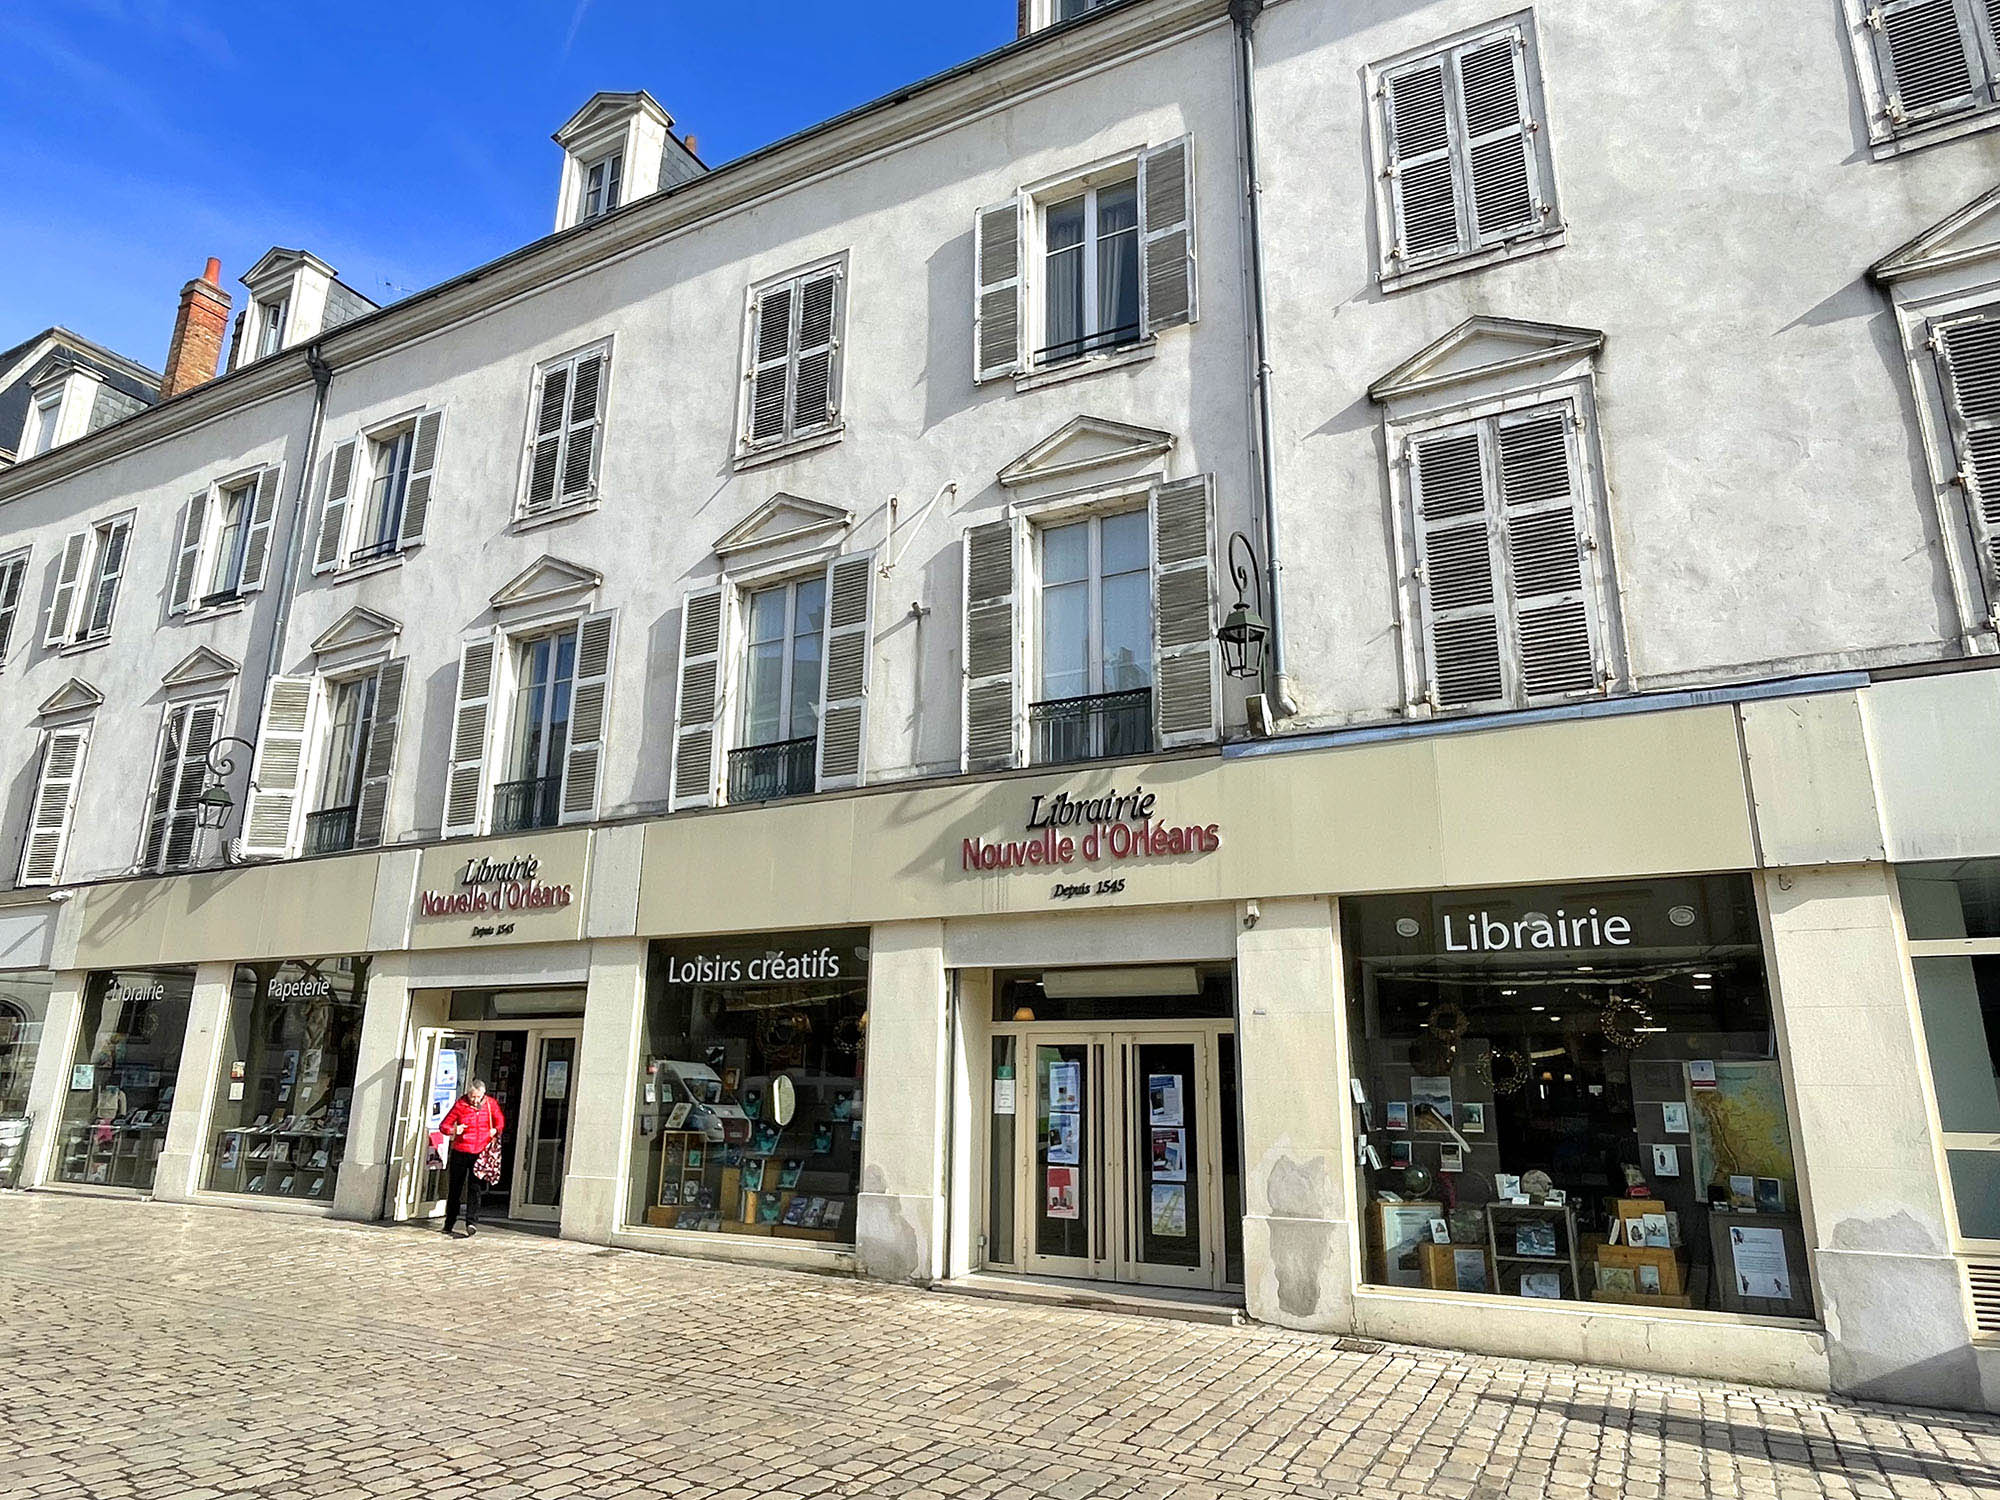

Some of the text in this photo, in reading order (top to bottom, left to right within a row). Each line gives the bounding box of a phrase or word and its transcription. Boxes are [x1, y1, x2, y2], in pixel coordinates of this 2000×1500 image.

[1025, 785, 1156, 831] Librairie
[962, 818, 1221, 870] Nouvelle d'Orléans
[461, 854, 539, 886] Librairie
[421, 879, 572, 916] Nouvelle d'Orléans
[1053, 878, 1126, 899] Depuis 1545
[472, 925, 494, 938] Depuis
[1443, 907, 1632, 951] Librairie
[668, 947, 840, 983] Loisirs créatifs
[111, 980, 164, 1001] Librairie
[267, 976, 330, 1002] Papeterie
